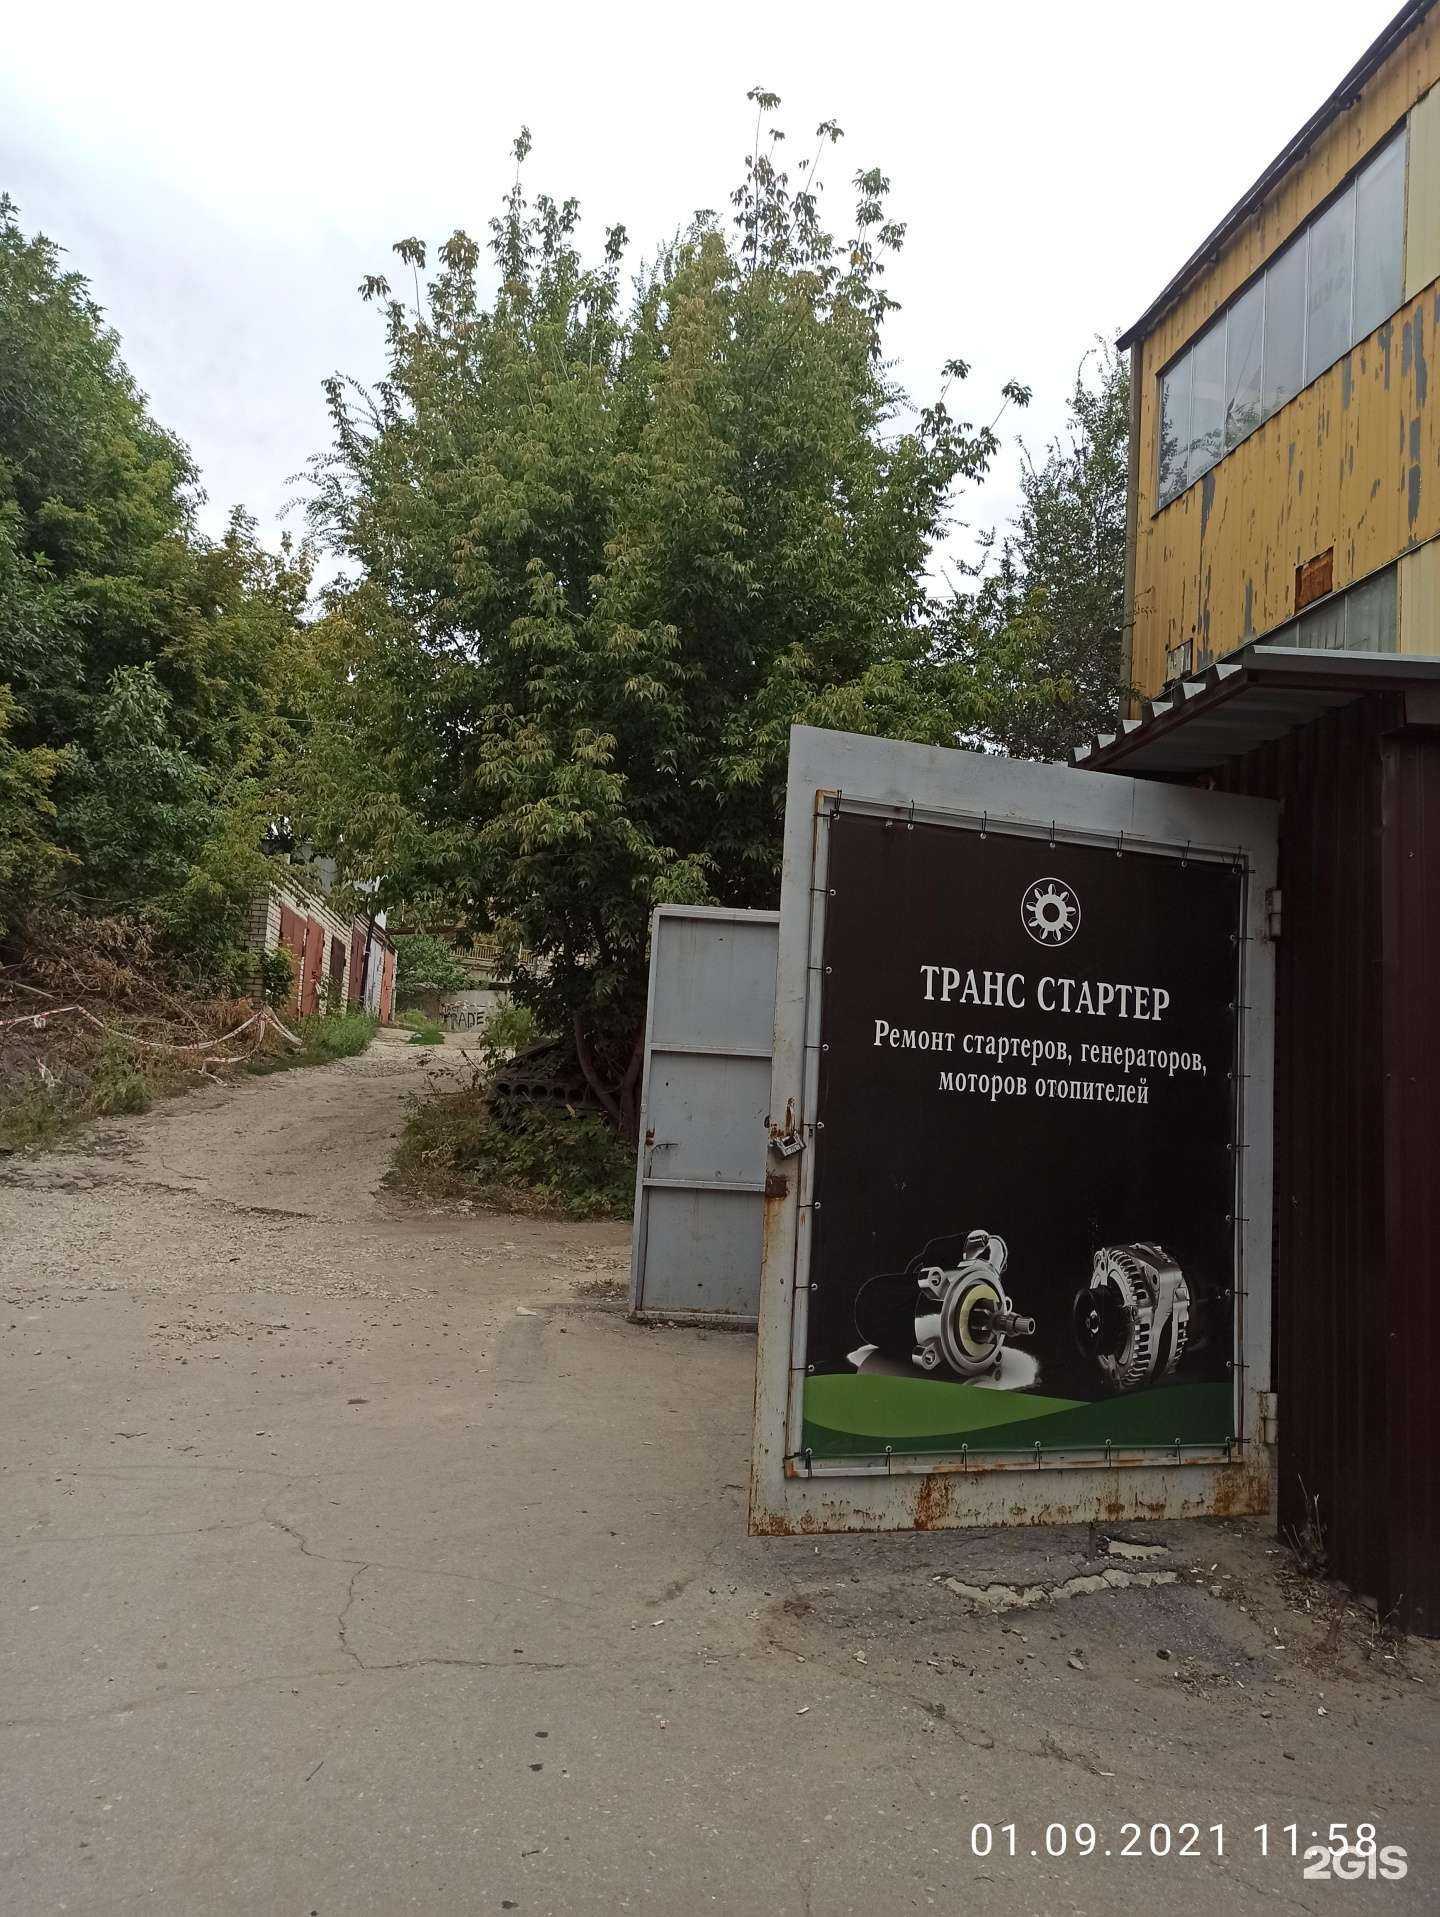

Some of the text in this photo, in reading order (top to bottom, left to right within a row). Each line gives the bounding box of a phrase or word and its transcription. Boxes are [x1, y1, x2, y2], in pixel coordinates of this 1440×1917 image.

[920, 966, 1170, 1021] ТРАНС СТАРТЕР
[874, 1020, 1207, 1076] Ремонт стартеров, генераторов,
[939, 1071, 1149, 1104] моторов отопителей
